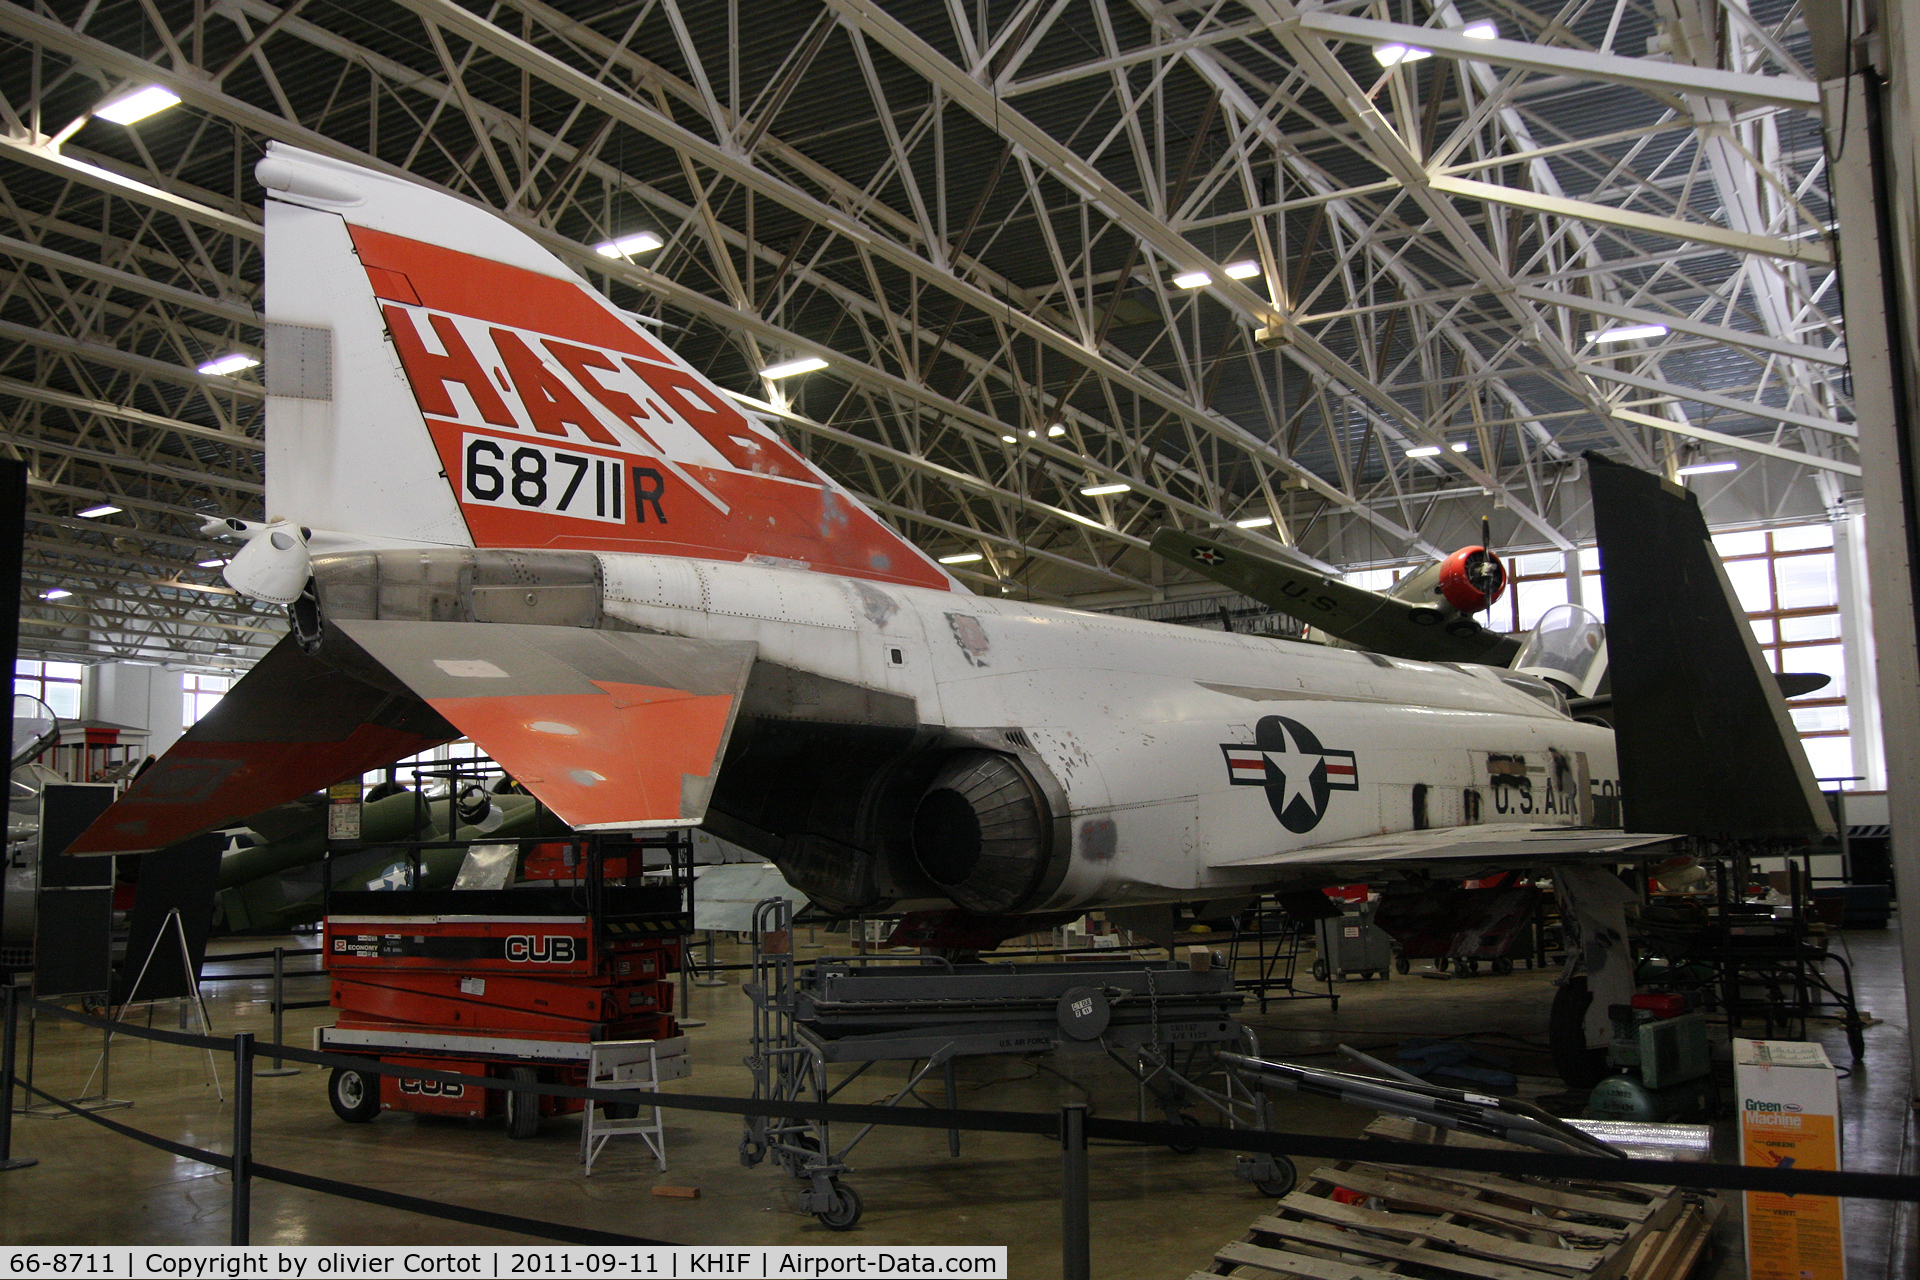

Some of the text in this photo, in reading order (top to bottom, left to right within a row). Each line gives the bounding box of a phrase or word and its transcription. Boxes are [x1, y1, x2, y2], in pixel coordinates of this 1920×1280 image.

[467, 439, 622, 520] 68711
[347, 944, 379, 952] ECONOMY
[505, 934, 575, 964] CUB
[1027, 1036, 1050, 1046] FORCE
[1745, 1098, 1781, 1112] Green
[1746, 1111, 1802, 1127] Machine
